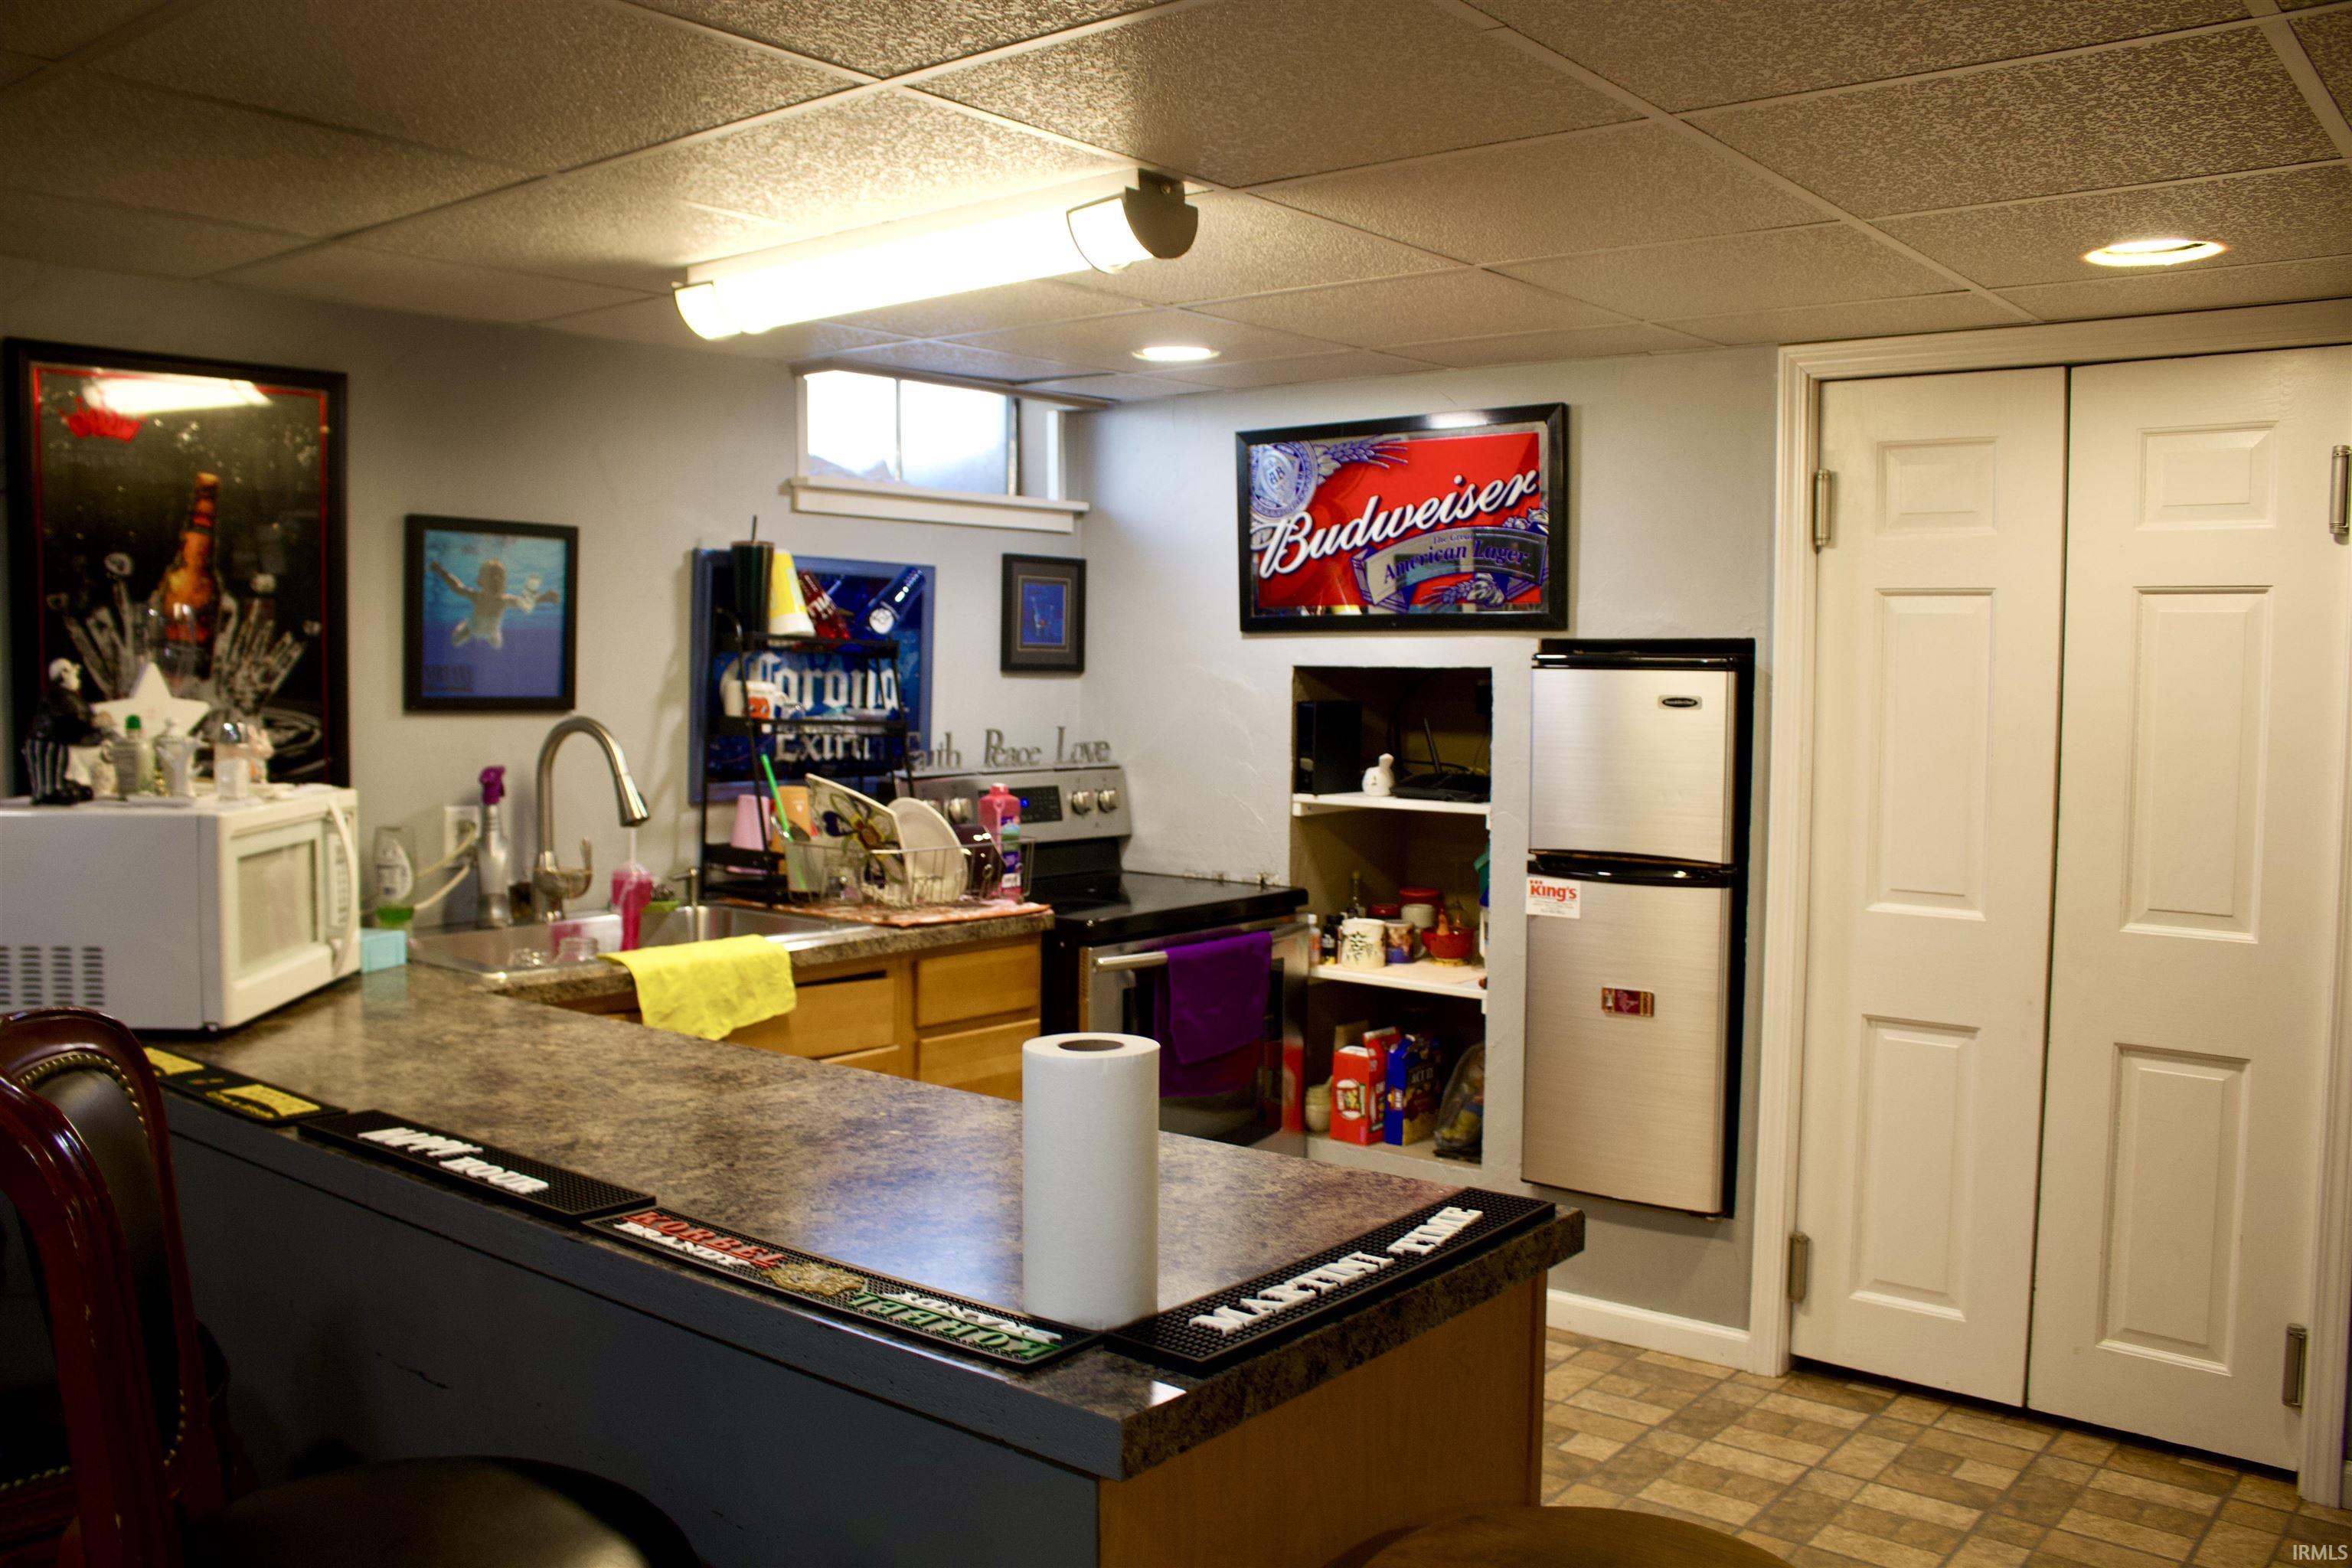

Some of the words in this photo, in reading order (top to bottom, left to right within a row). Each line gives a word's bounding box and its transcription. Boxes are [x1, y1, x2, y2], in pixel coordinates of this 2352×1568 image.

[1251, 470, 1540, 580] Budweiser
[1384, 544, 1468, 583] American
[1473, 540, 1529, 566] Lager
[984, 728, 1042, 766] Peace
[1055, 726, 1110, 763] Love
[1530, 884, 1577, 902] King's
[614, 1221, 753, 1269] BRANDY
[619, 1210, 786, 1269] KORBEL
[1188, 1250, 1396, 1337] MARTINI
[1387, 1206, 1485, 1256] TIME
[848, 1291, 1062, 1359] KORBEL
